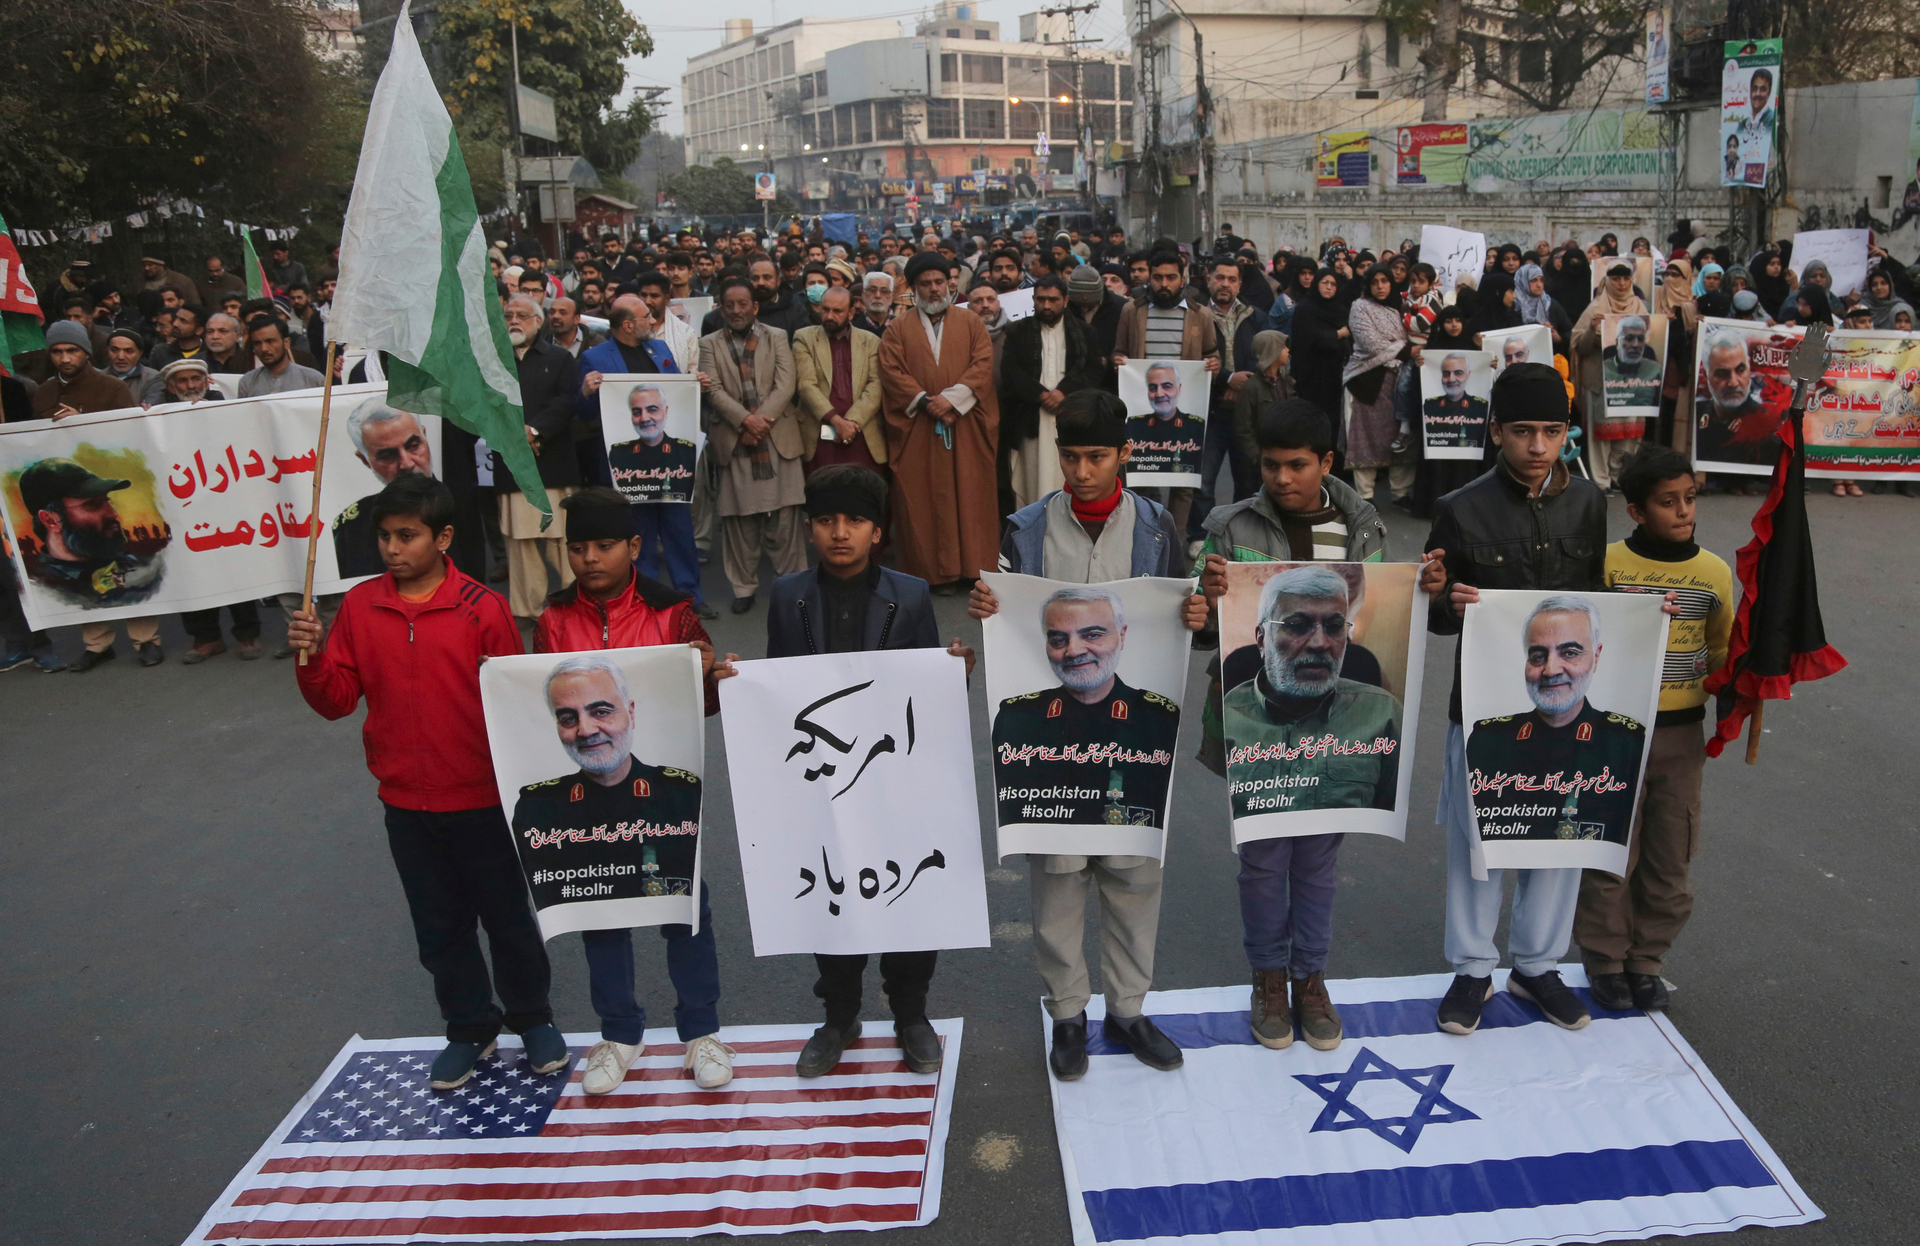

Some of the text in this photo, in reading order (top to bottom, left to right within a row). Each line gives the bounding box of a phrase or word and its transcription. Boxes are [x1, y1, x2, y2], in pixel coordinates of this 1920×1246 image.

[1507, 157, 1560, 178] CO-OPERATIVE
[1562, 155, 1592, 176] SUPPLY
[1594, 153, 1657, 175] CORPORATION
[881, 182, 905, 195] Cake
[1130, 455, 1171, 463] isopakistan
[619, 485, 660, 493] sopakistan
[185, 502, 325, 552] مقاومت
[1643, 572, 1666, 582] did
[785, 679, 915, 801] امریکہ
[1284, 737, 1307, 760] شہید
[1323, 738, 1348, 757] امام
[1345, 740, 1371, 755] روضہ
[1370, 737, 1397, 754] محافظ
[1026, 745, 1049, 766] قاسم
[1076, 743, 1097, 763] شہید
[1109, 746, 1131, 767] امام
[1129, 750, 1151, 763] روضہ
[1150, 749, 1171, 765] محافظ
[1247, 742, 1275, 762] مہدی
[1272, 742, 1286, 760] ابو
[1229, 774, 1320, 797] #isopakistan
[1497, 773, 1527, 798] قاسم
[1559, 771, 1583, 794] شہید
[1575, 777, 1597, 799] حرم
[1595, 766, 1627, 794] مدافع
[999, 785, 1101, 801] #isopakistan
[1246, 794, 1296, 811] #isolhr
[1021, 805, 1076, 819] #isolhr
[1474, 804, 1557, 819] sopakistan
[604, 822, 623, 842] شہید
[639, 822, 660, 843] امام
[660, 823, 681, 836] روضہ
[680, 821, 698, 836] محافظ
[1482, 822, 1532, 836] #isolhr
[557, 828, 579, 849] قاسم
[533, 863, 636, 885] #isopakistan
[795, 845, 945, 916] مردہ باد
[561, 883, 614, 898] #isolhr
